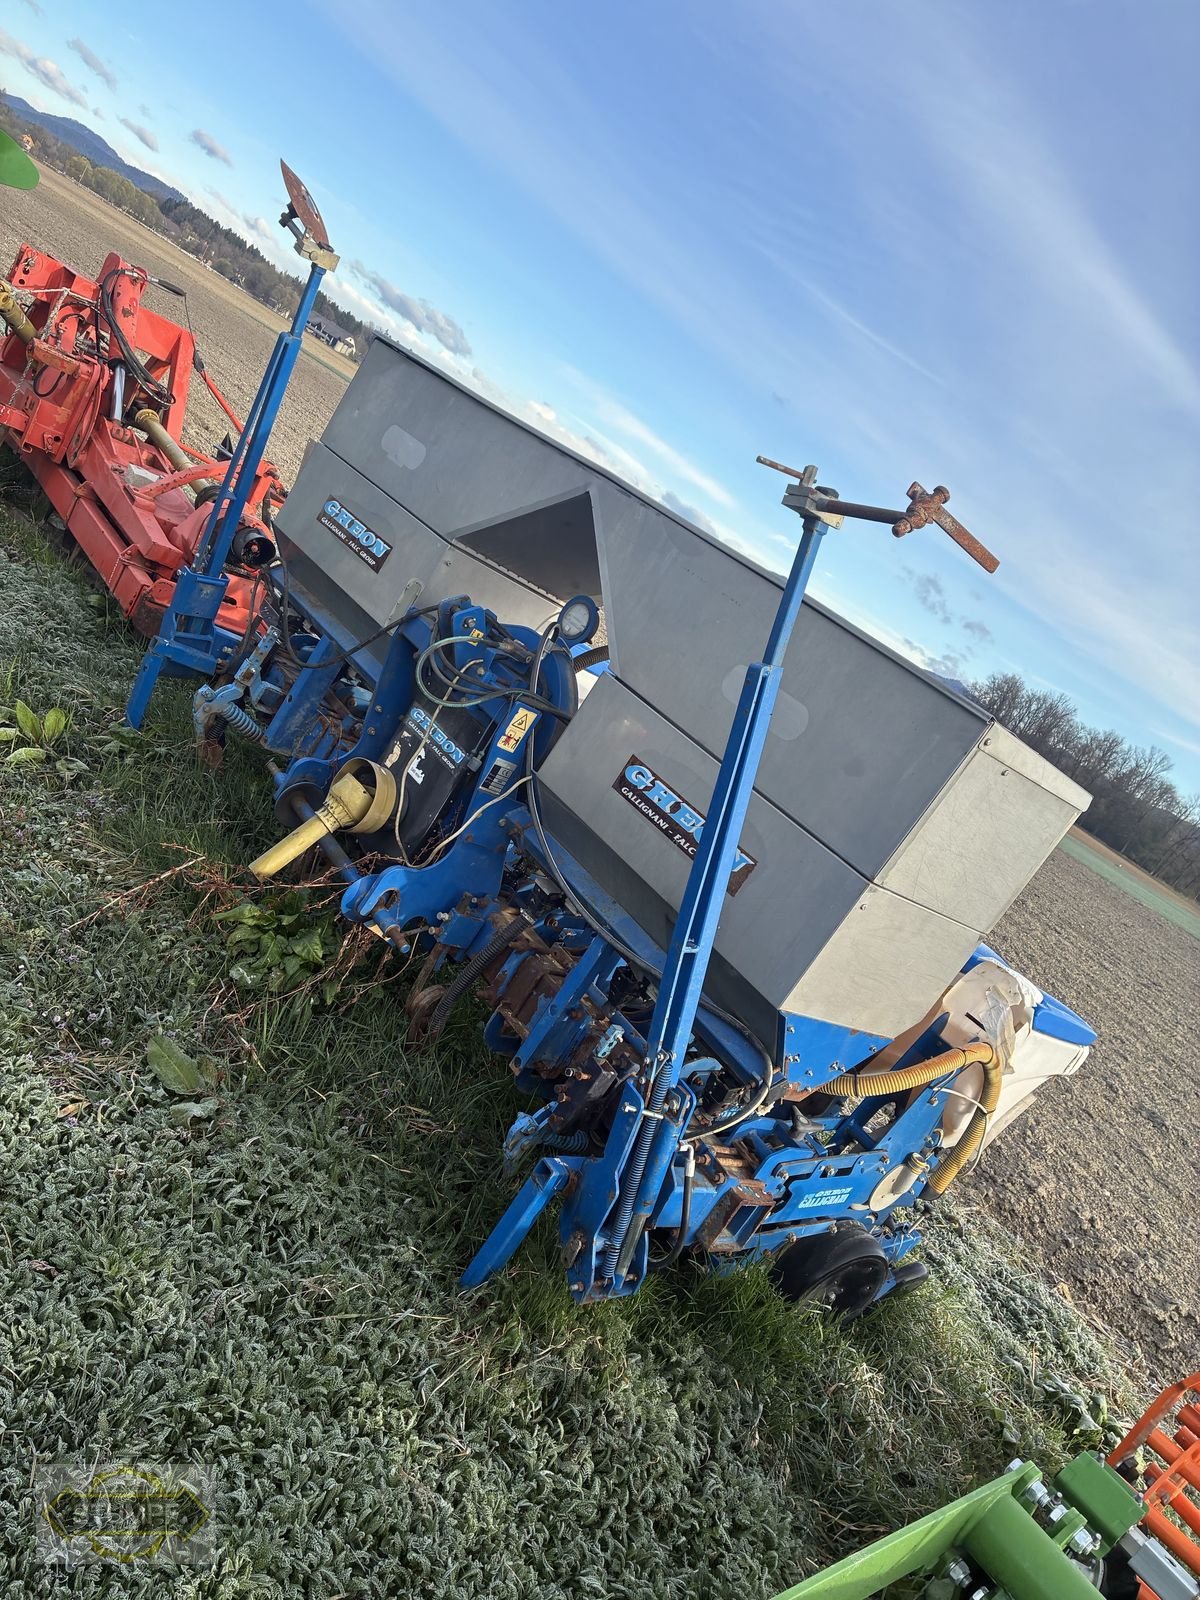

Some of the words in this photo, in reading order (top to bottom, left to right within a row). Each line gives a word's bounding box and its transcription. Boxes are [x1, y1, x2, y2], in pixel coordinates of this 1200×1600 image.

[323, 500, 391, 557] GHEON
[359, 551, 376, 566] GROUP
[621, 786, 669, 830] GALLIGNANI
[673, 833, 697, 855] FALC
